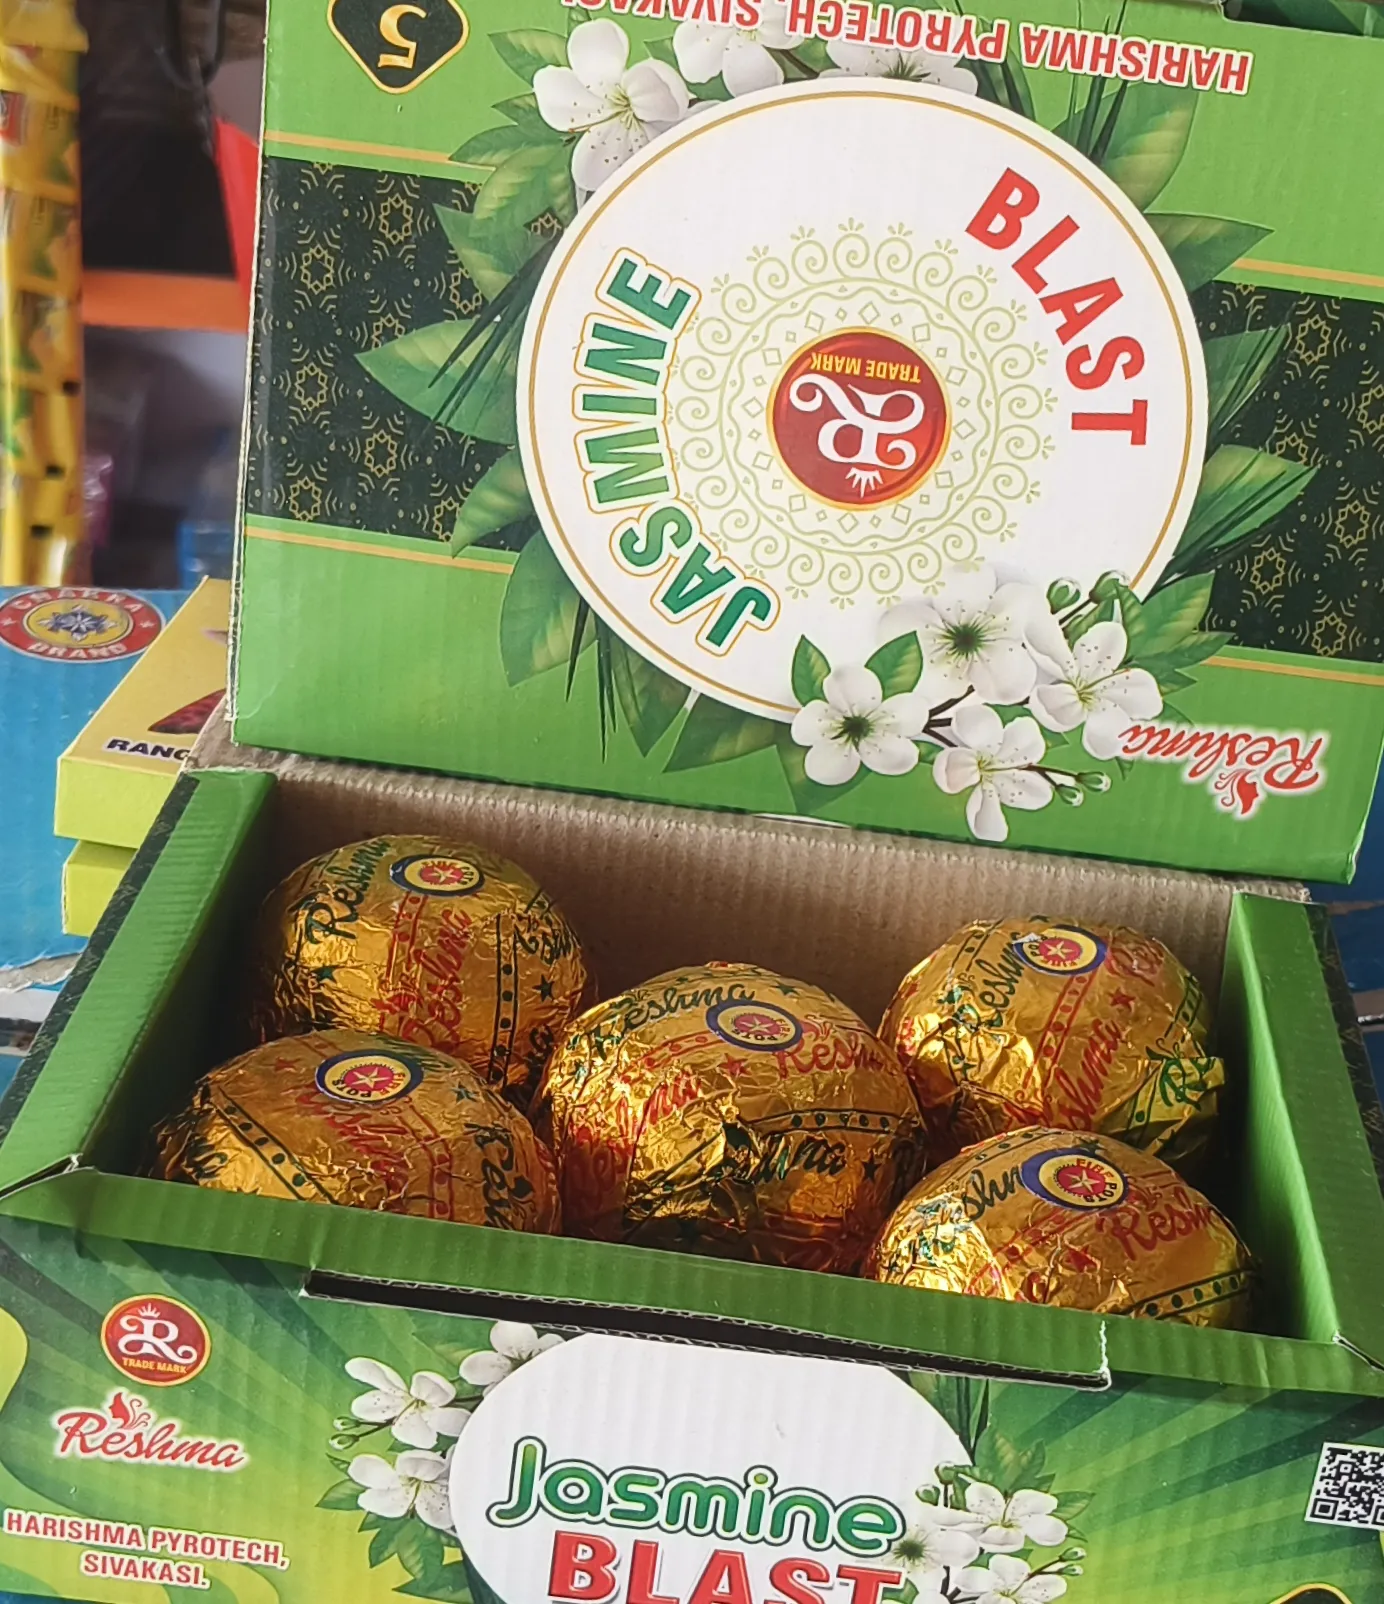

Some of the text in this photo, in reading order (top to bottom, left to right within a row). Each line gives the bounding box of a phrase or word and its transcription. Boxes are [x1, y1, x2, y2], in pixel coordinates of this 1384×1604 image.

[376, 3, 428, 70] 5
[778, 0, 1005, 60] PYROTECH
[1022, 26, 1250, 92] HARISHMA
[964, 166, 1149, 446] BLAST
[809, 351, 922, 384] TRADE MARK
[579, 254, 775, 650] JASMINE
[26, 642, 128, 659] BRAND
[1117, 724, 1323, 790] Reshma
[331, 1079, 373, 1098] POTS
[1075, 1157, 1118, 1204] FIRE POTS
[121, 1356, 188, 1374] TRADE MARK
[57, 1411, 245, 1468] Reshma
[490, 1439, 902, 1555] Jasmine
[6, 1511, 288, 1568] HARISHMA PYROTECH,
[546, 1529, 904, 1604] BLAST
[83, 1553, 208, 1587] SIVAKASI.
